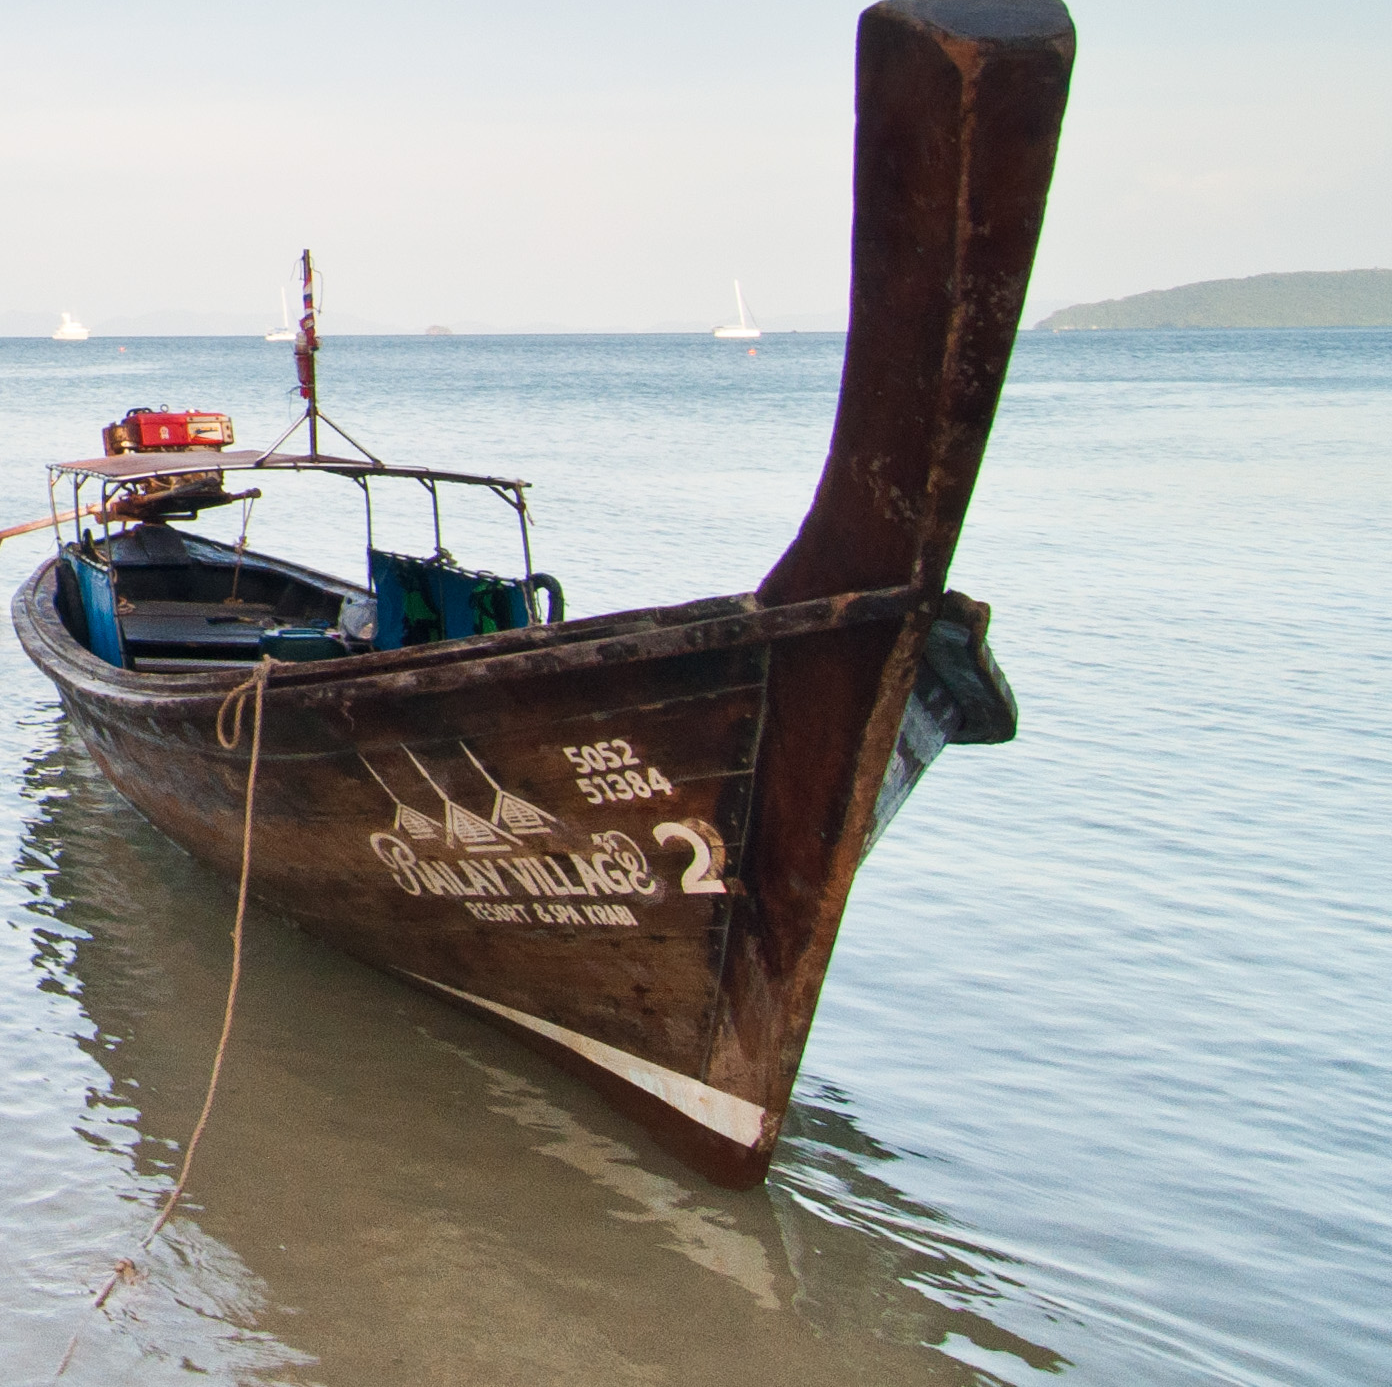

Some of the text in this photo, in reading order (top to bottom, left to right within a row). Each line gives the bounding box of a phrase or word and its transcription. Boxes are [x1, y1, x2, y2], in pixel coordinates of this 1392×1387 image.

[562, 739, 641, 774] 5052
[576, 767, 673, 805] 51384
[369, 821, 727, 897] RAILAY VILLAGE 2
[465, 901, 533, 924] RESORT
[581, 904, 639, 927] KRABI
